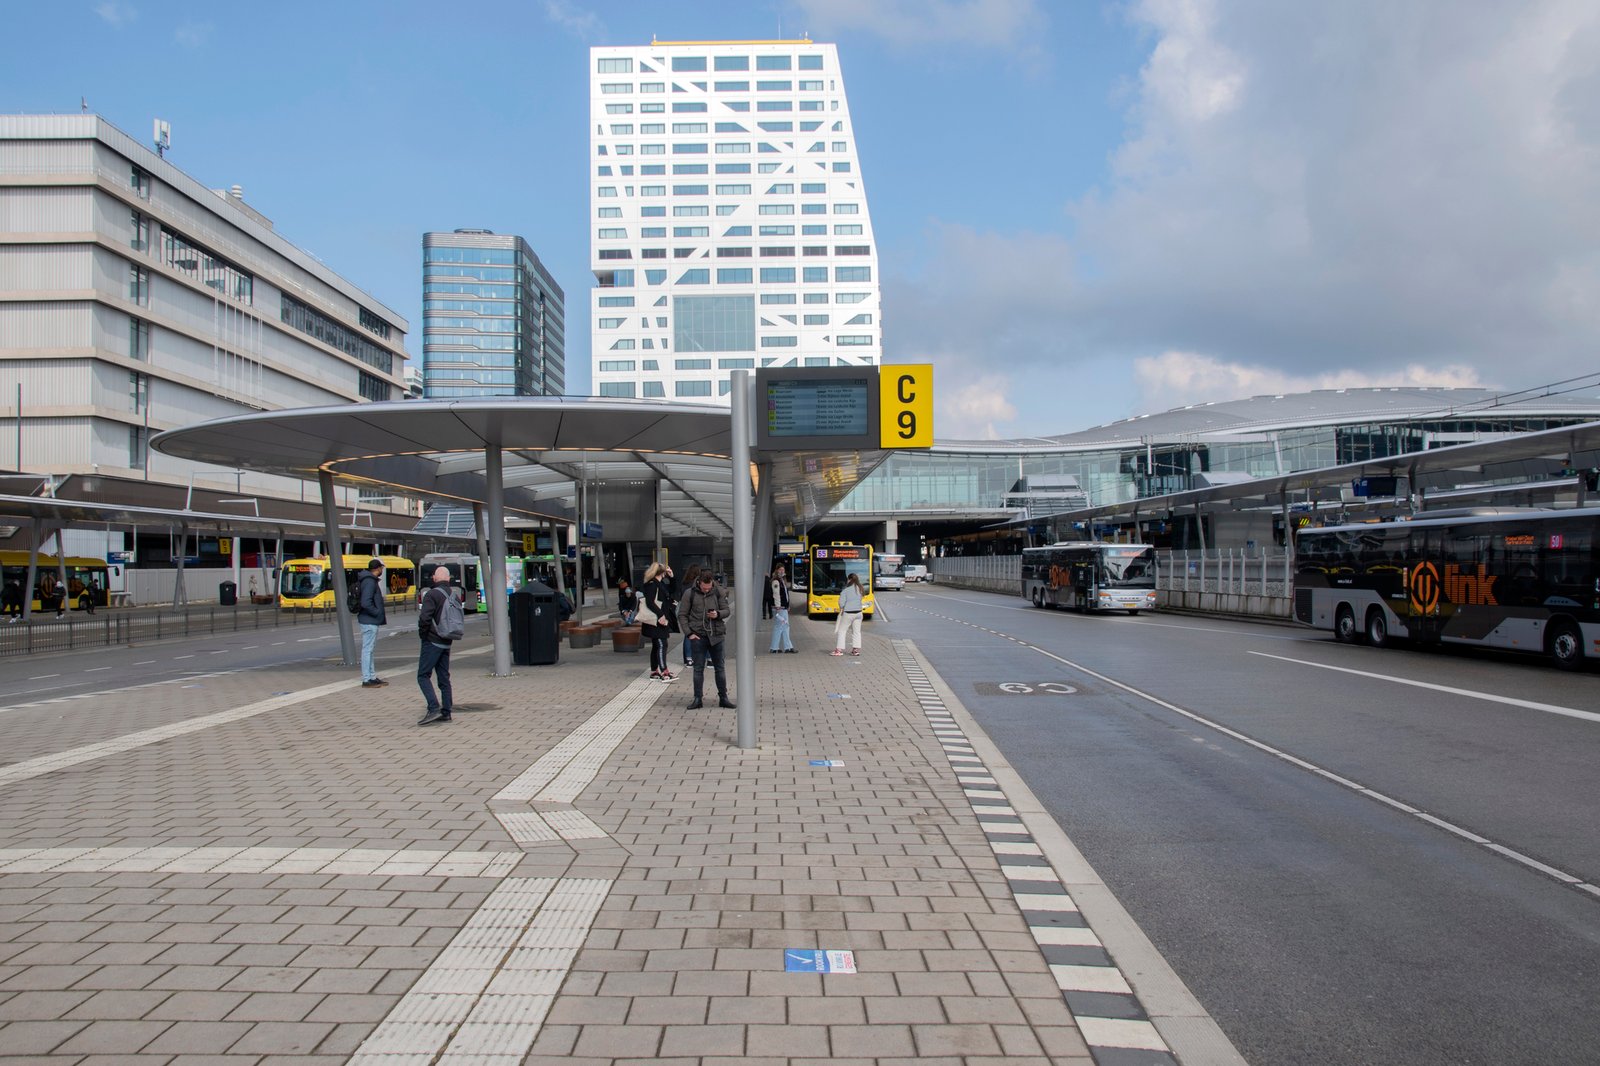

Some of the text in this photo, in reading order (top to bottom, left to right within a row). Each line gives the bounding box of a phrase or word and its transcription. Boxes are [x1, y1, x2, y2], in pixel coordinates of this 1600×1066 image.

[897, 374, 915, 404] C
[898, 410, 917, 440] 9
[1551, 535, 1559, 548] 50
[1444, 563, 1499, 606] link
